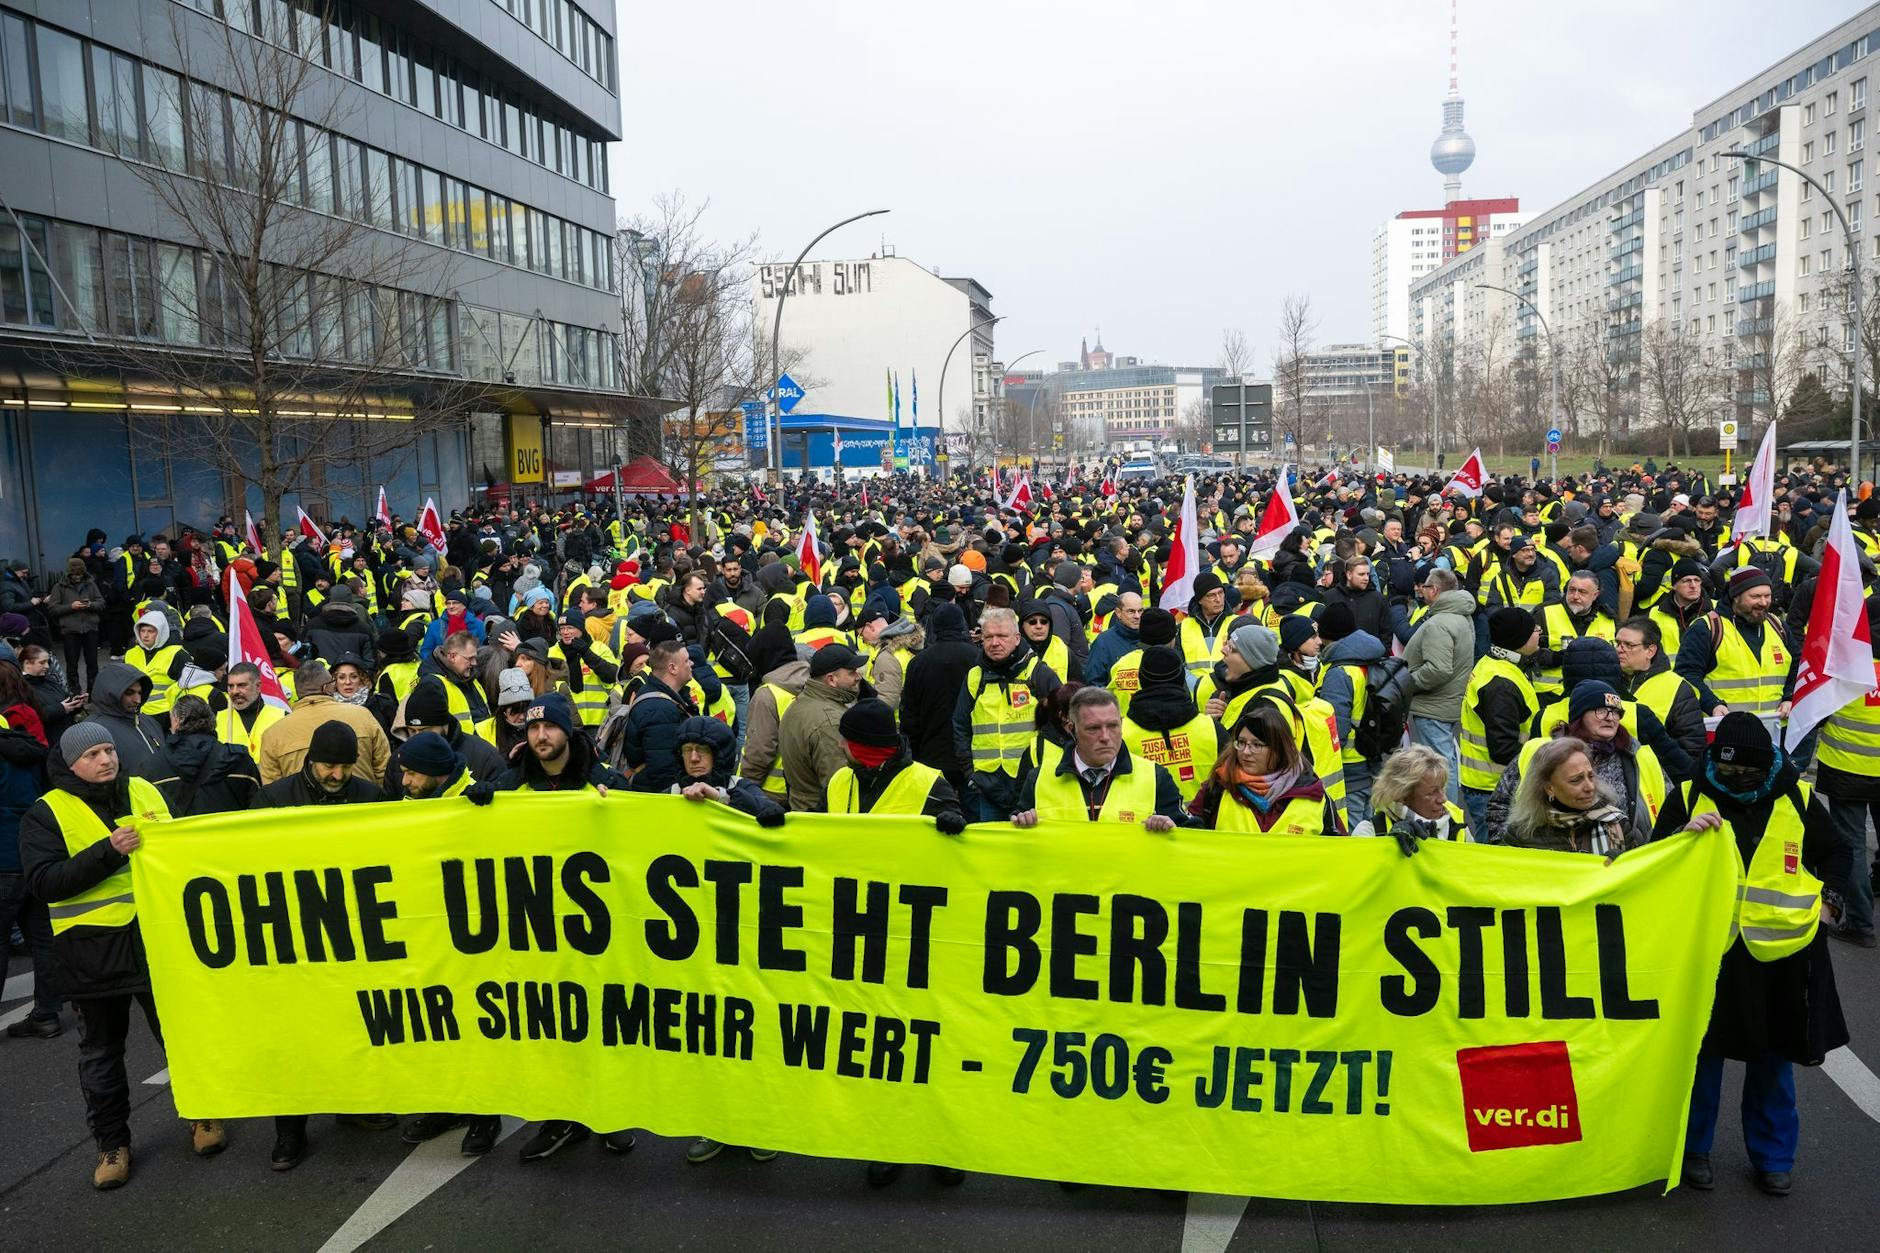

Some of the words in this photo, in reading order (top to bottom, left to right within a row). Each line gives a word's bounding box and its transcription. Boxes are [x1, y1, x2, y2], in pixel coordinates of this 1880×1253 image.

[518, 449, 539, 475] BVG
[1142, 736, 1190, 754] ZUSAMEN
[1168, 748, 1191, 761] MEHR
[183, 865, 408, 970] OHNE
[441, 851, 611, 957] UNS
[982, 890, 1342, 1018] BERLIN
[1380, 903, 1661, 1020] STILL
[356, 984, 461, 1047] WIR
[475, 980, 589, 1042] SIND
[601, 982, 755, 1061] MEHR
[778, 1003, 941, 1085] WERT
[962, 1059, 983, 1072] -
[1011, 1027, 1175, 1105] 750€
[1194, 1045, 1394, 1117] JETZT!
[1473, 1105, 1569, 1129] ver.di
